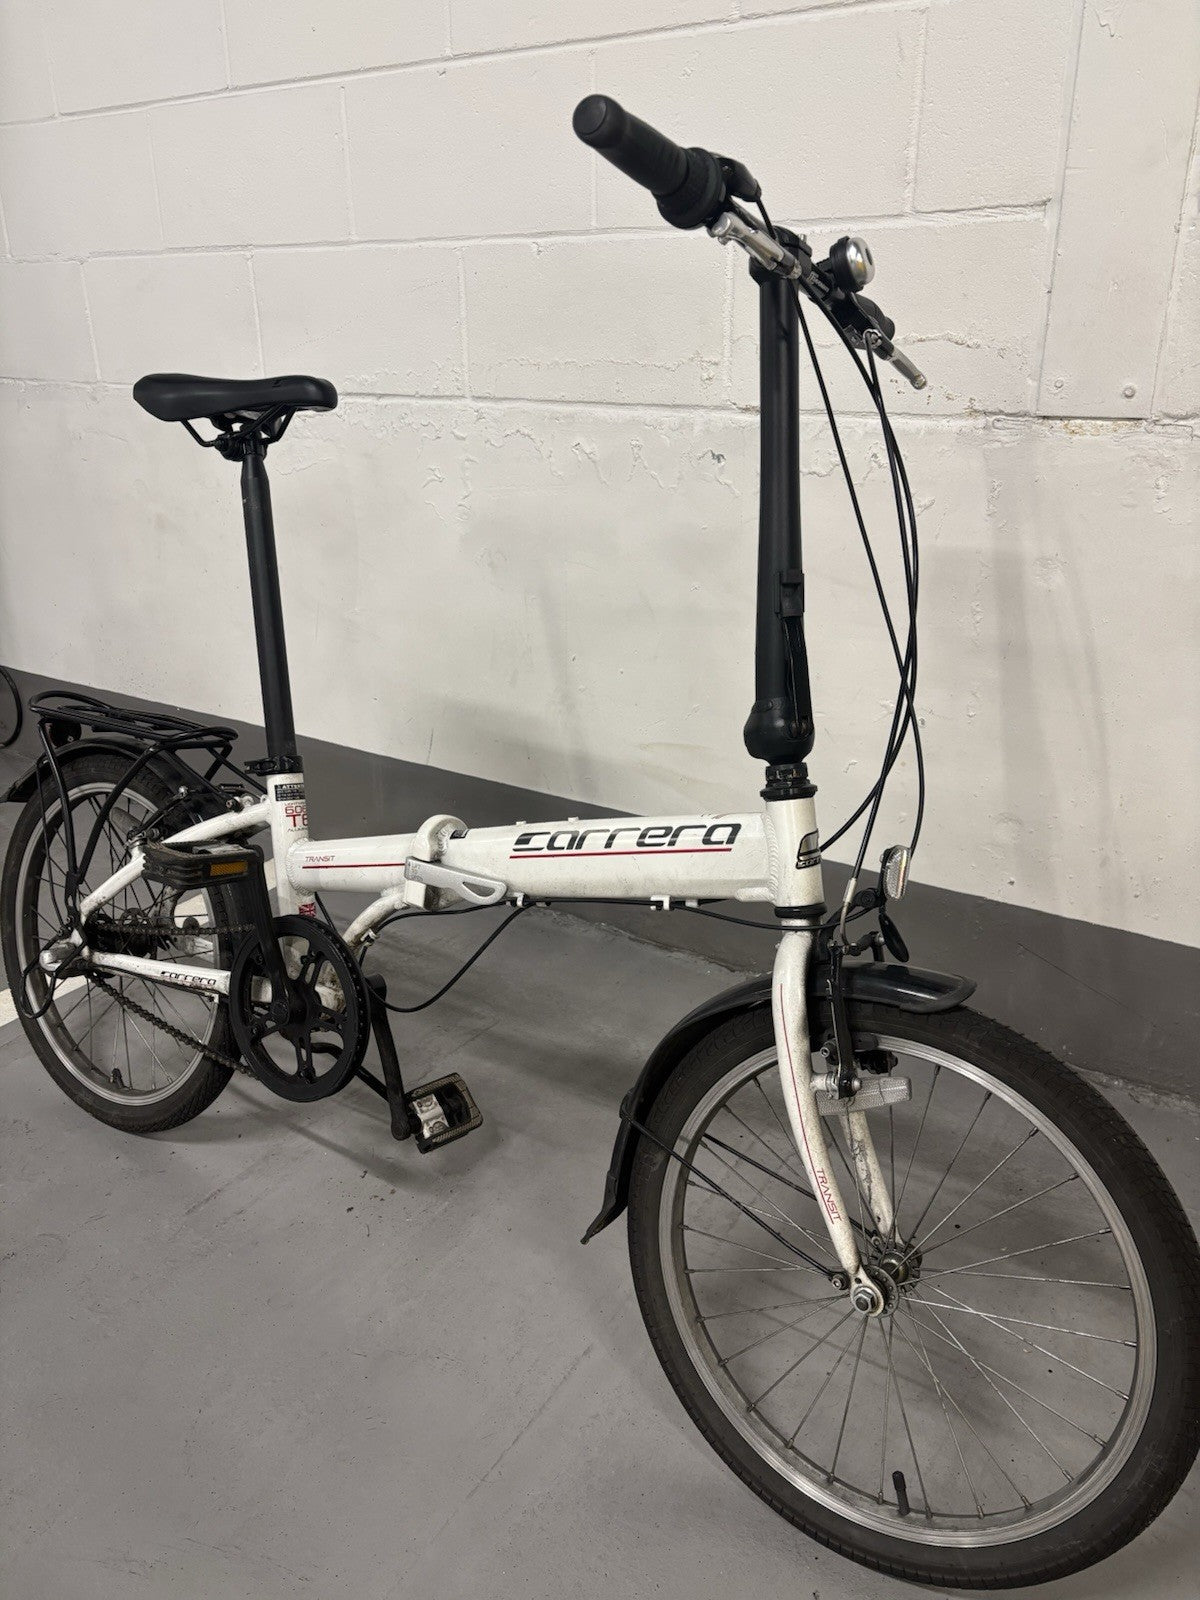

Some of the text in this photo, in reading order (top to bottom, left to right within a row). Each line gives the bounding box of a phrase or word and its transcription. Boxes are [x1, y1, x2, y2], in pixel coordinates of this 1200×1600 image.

[512, 823, 742, 852] carrera
[305, 855, 336, 863] TRANSIT
[160, 971, 217, 986] carrera
[816, 1167, 843, 1222] TRANSIT
